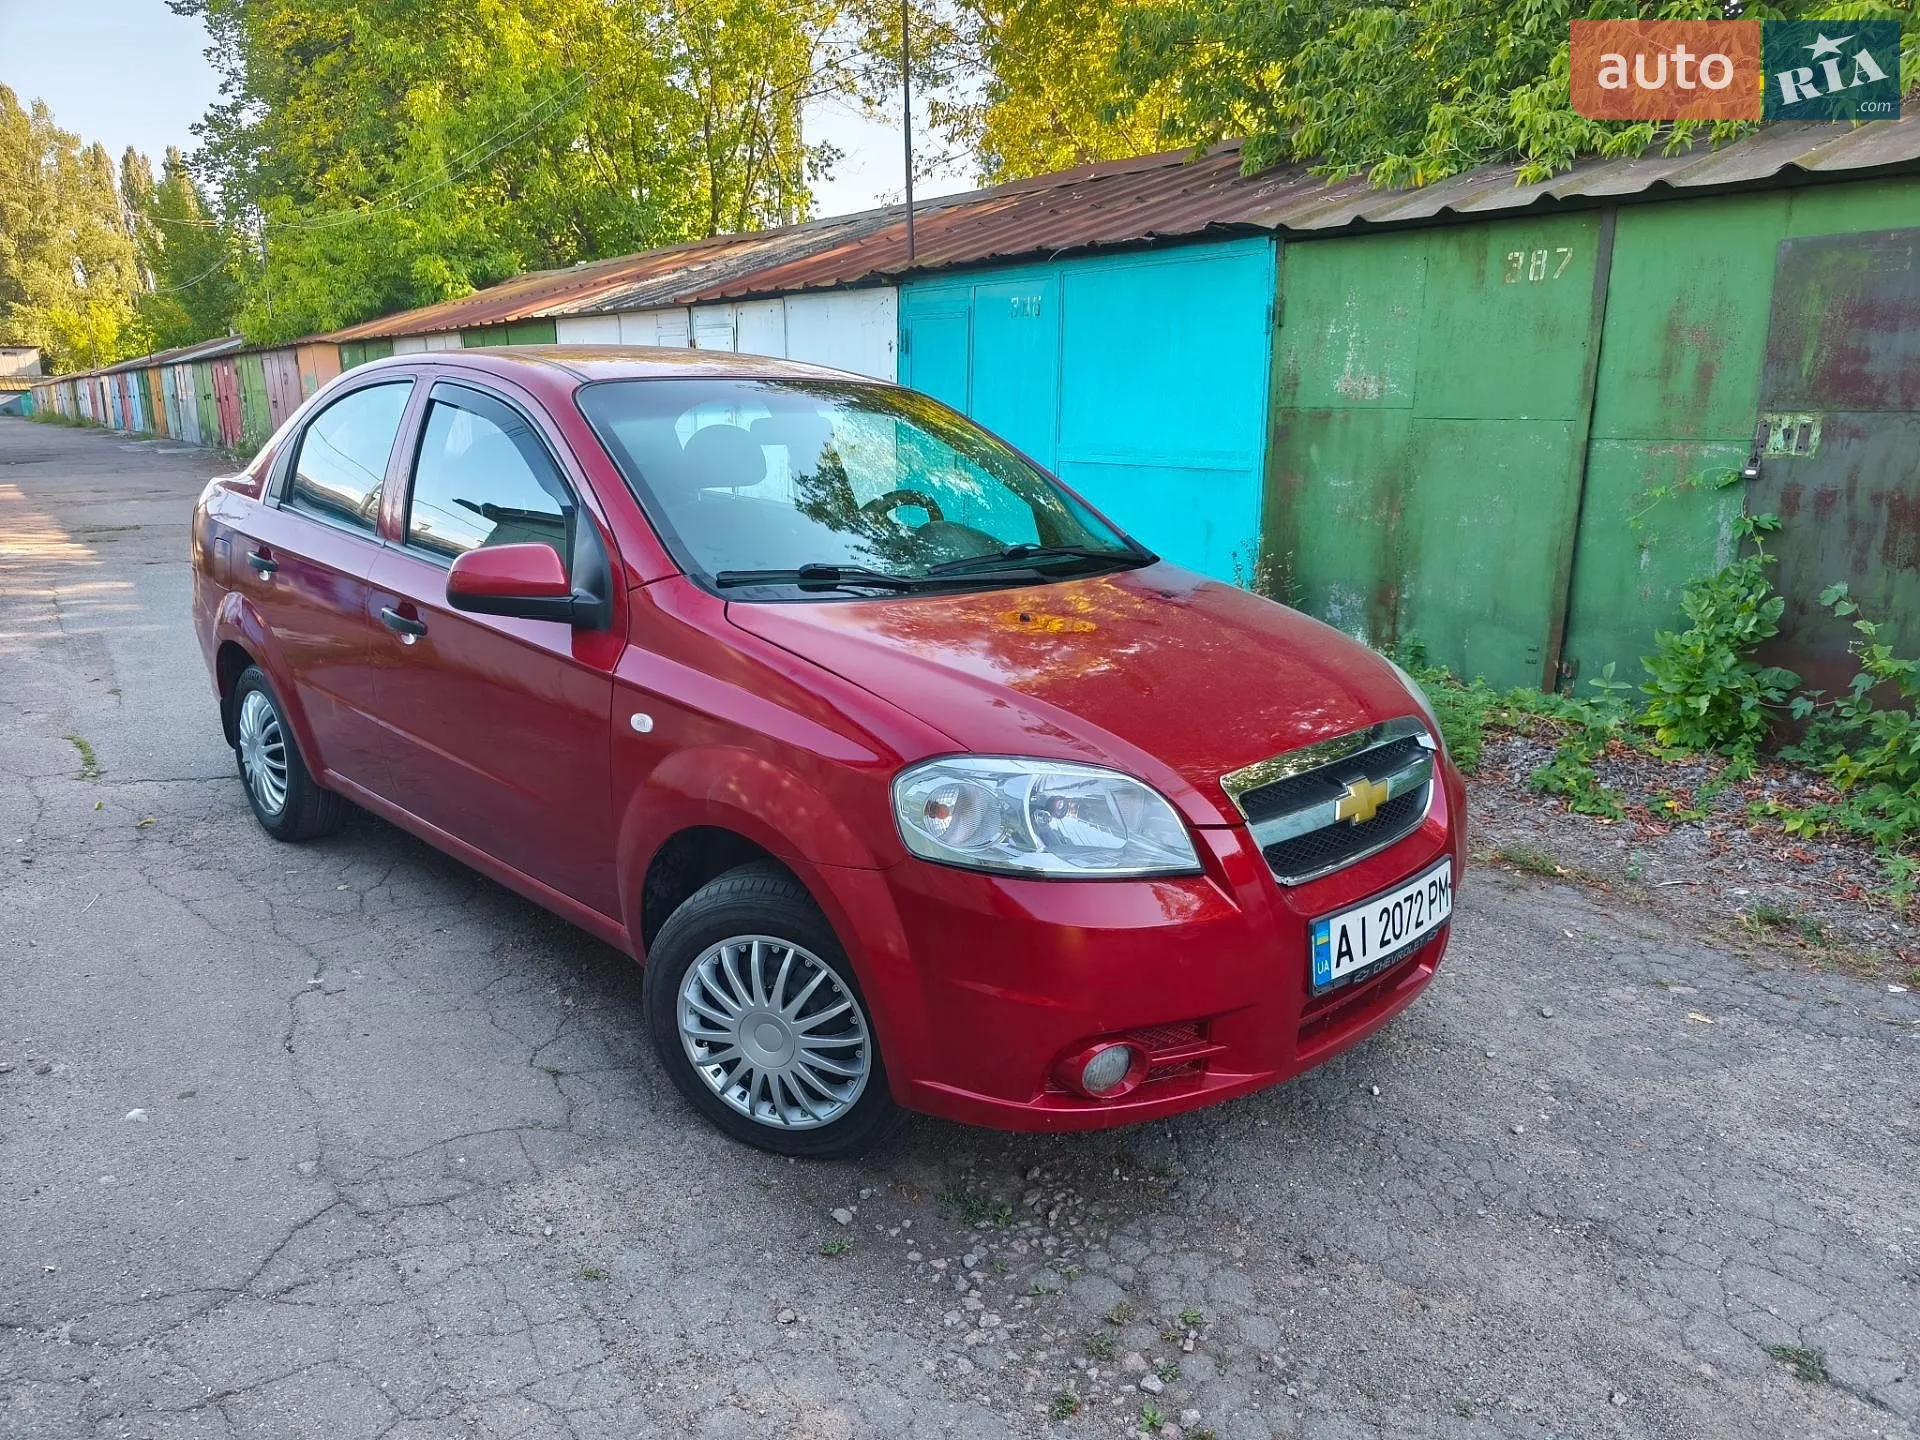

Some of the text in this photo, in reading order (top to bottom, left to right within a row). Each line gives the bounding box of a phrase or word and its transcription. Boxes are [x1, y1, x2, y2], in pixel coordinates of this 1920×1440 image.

[1505, 247, 1573, 284] 387
[1336, 871, 1449, 968] AI 2072 PM
[1317, 959, 1330, 975] UA
